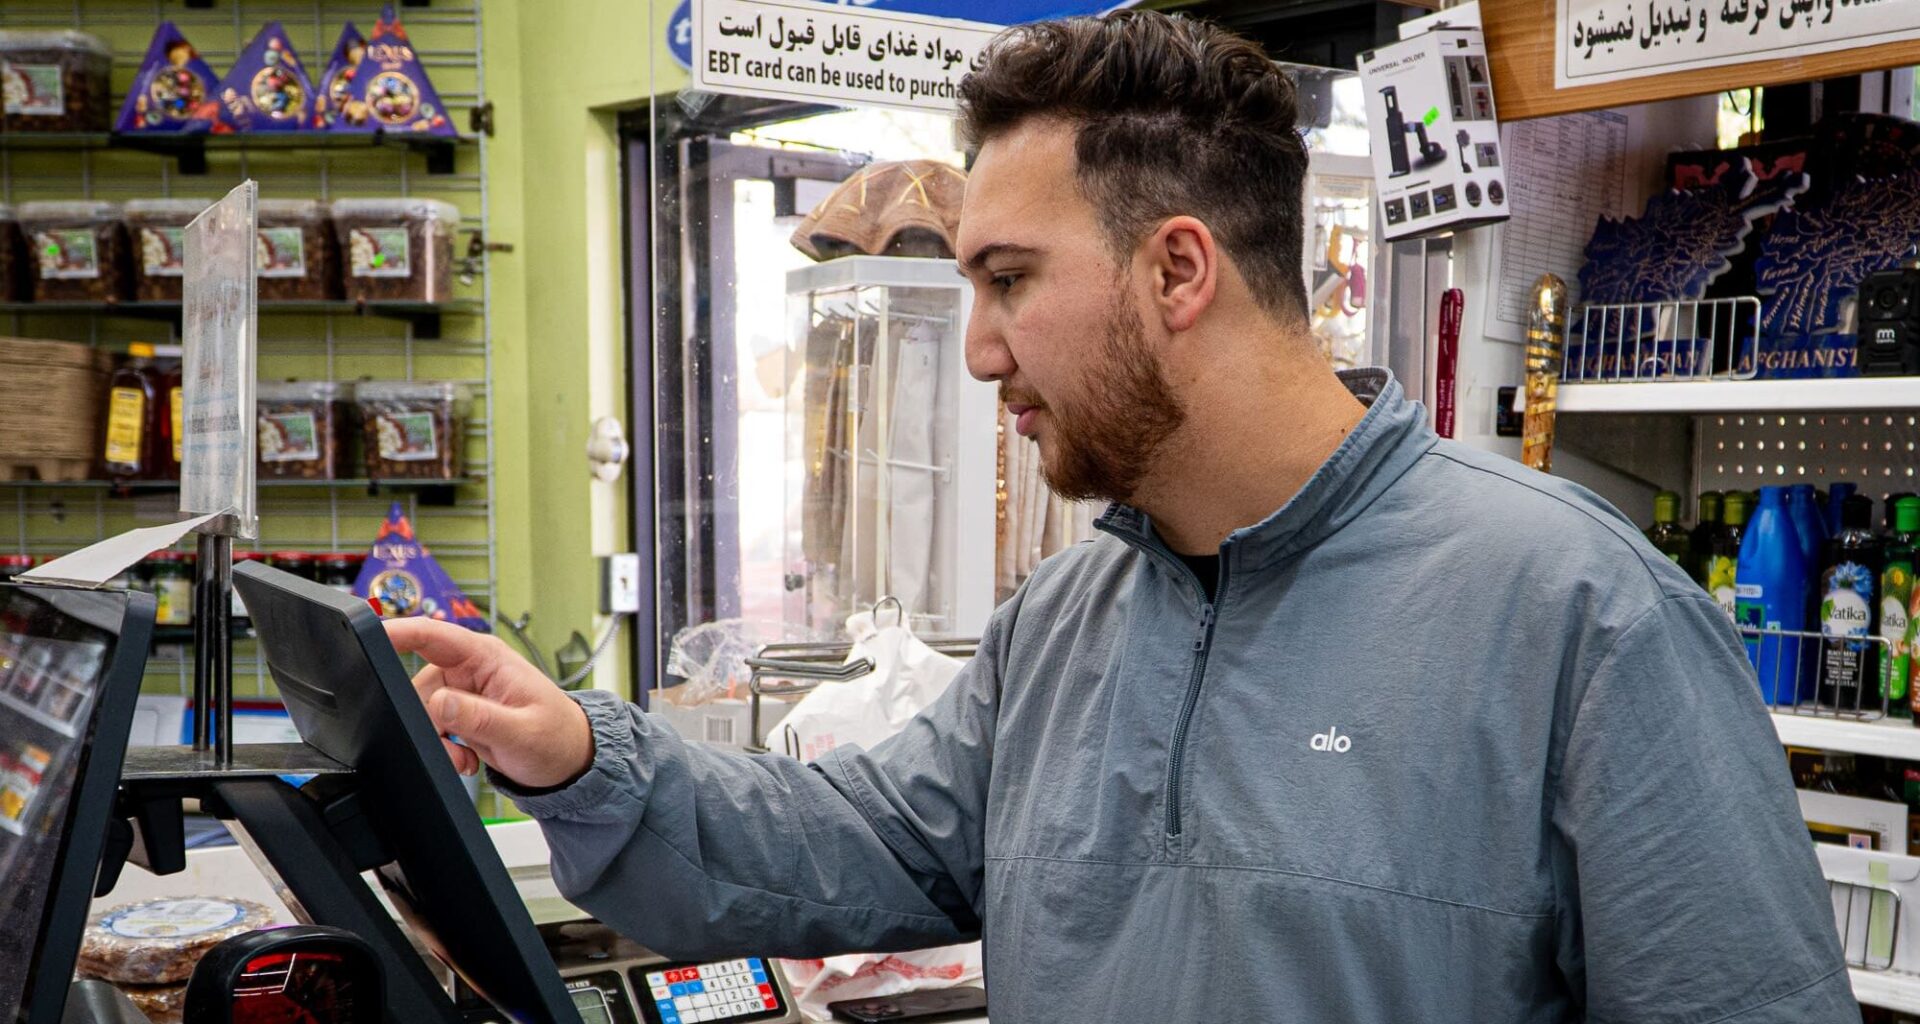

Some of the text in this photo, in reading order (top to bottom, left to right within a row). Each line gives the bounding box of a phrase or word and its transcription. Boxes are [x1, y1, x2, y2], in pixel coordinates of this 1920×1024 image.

[719, 14, 762, 39] است
[769, 16, 815, 52] قبول
[822, 24, 861, 56] قابل
[1574, 4, 1634, 59] نمیشود
[868, 30, 918, 61] غذای
[925, 37, 963, 70] مواد
[1402, 52, 1426, 66] HOLDER
[708, 49, 741, 75] EBT
[745, 57, 783, 80] card
[787, 64, 816, 84] can
[821, 62, 841, 86] be
[846, 68, 884, 91] used
[889, 73, 905, 93] to
[1310, 725, 1352, 753] alo
